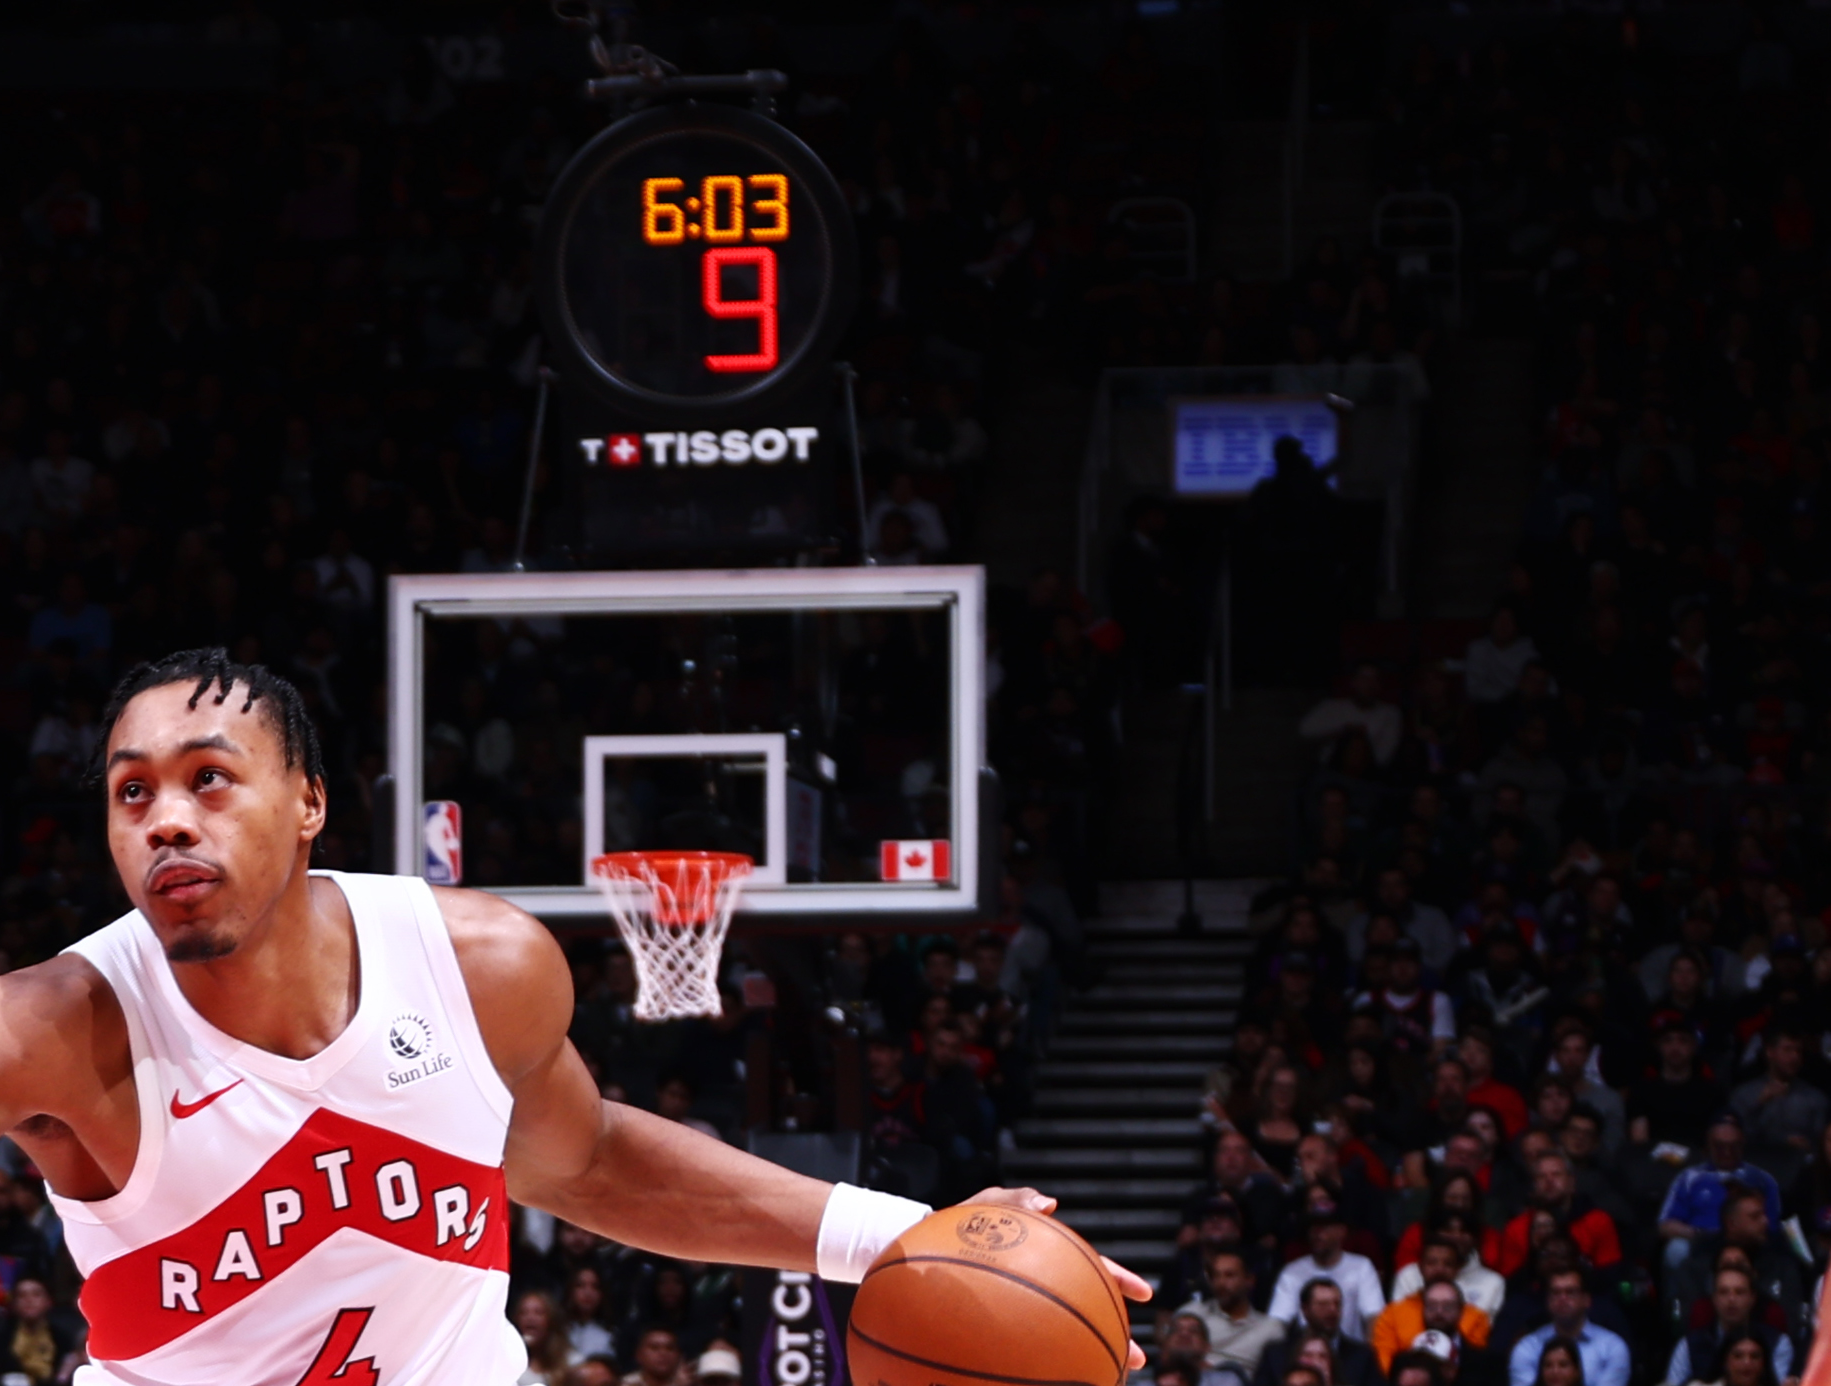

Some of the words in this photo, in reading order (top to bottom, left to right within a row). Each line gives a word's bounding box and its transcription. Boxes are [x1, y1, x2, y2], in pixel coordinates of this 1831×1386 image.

[421, 34, 506, 80] 02
[642, 173, 790, 244] 6:03
[702, 246, 778, 372] 9
[645, 427, 819, 464] TISSOT
[388, 1068, 421, 1088] Sun
[421, 1053, 453, 1076] Life
[159, 1147, 491, 1314] RAPTORS
[772, 1269, 813, 1322] CI
